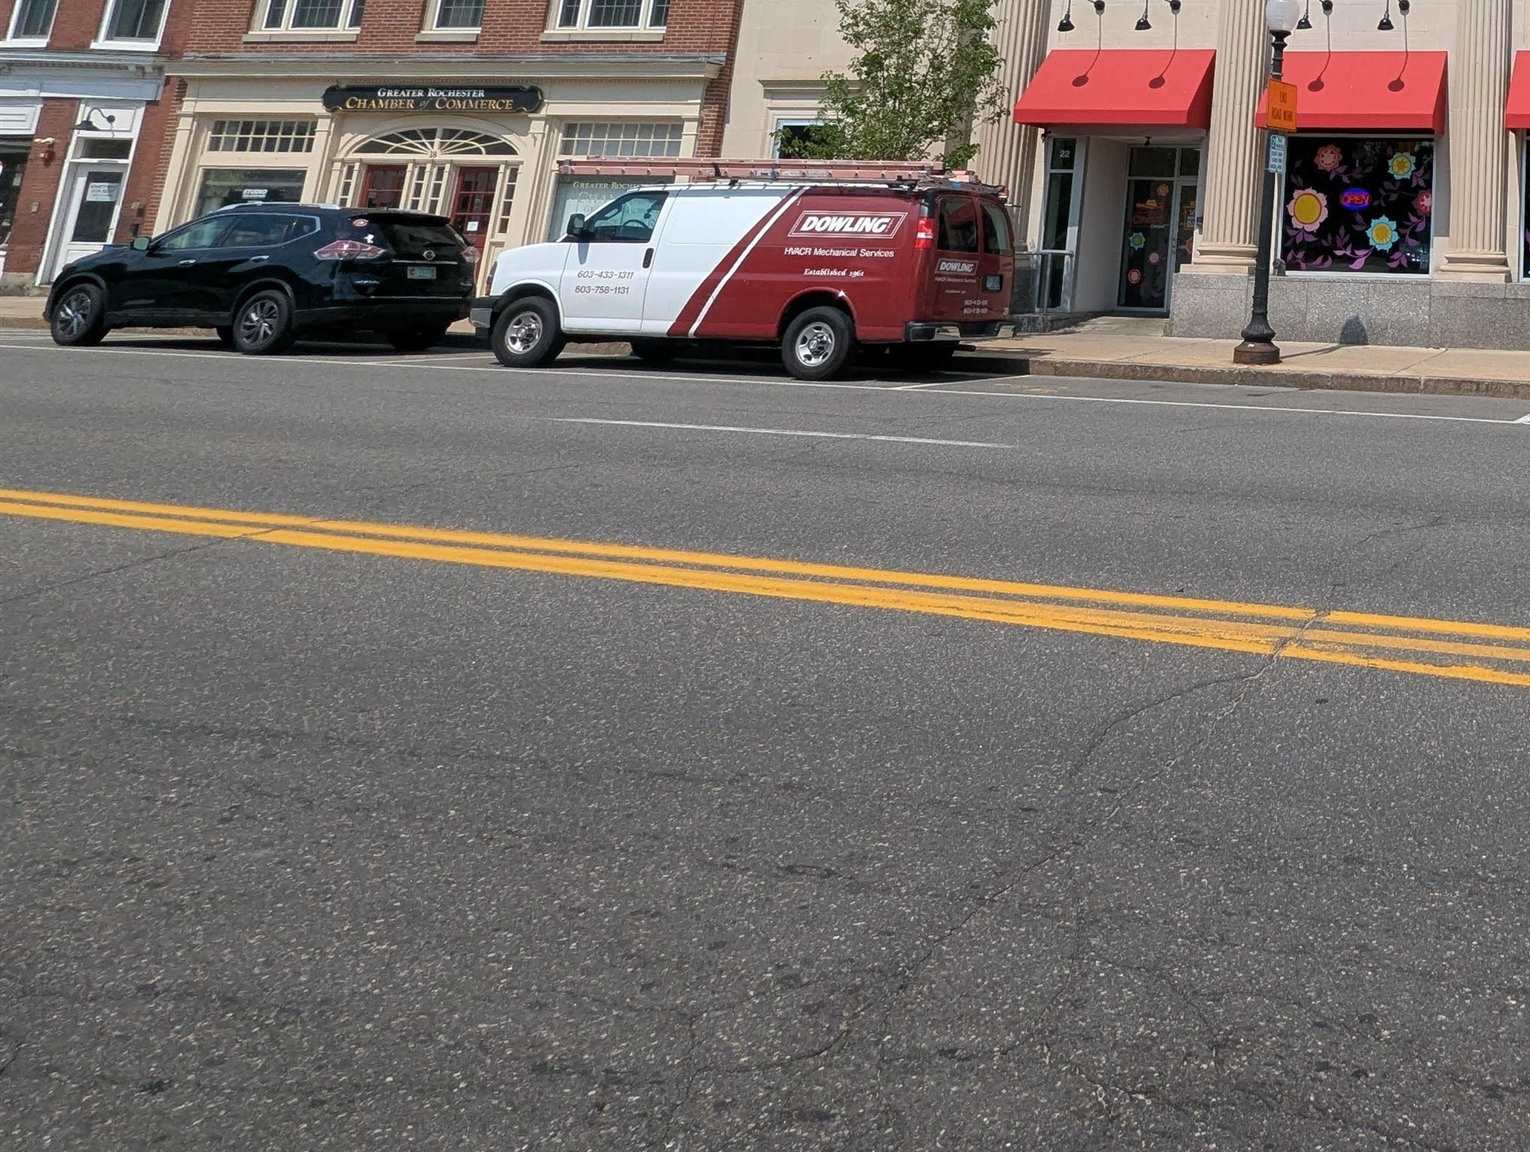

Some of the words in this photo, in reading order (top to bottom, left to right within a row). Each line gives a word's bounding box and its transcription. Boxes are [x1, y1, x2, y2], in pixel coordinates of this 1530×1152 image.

[377, 88, 424, 97] GREATER
[427, 88, 485, 97] ROCHESTER
[345, 96, 416, 109] CHAMBER
[419, 97, 432, 109] of
[435, 97, 514, 110] COMMERCE
[1059, 150, 1070, 158] 22
[800, 216, 891, 233] DOWLING
[814, 248, 857, 257] Mechanical
[859, 249, 895, 258] Services
[940, 262, 974, 272] DOWLING
[577, 270, 634, 279] 603-433-1311
[803, 268, 848, 277] Established
